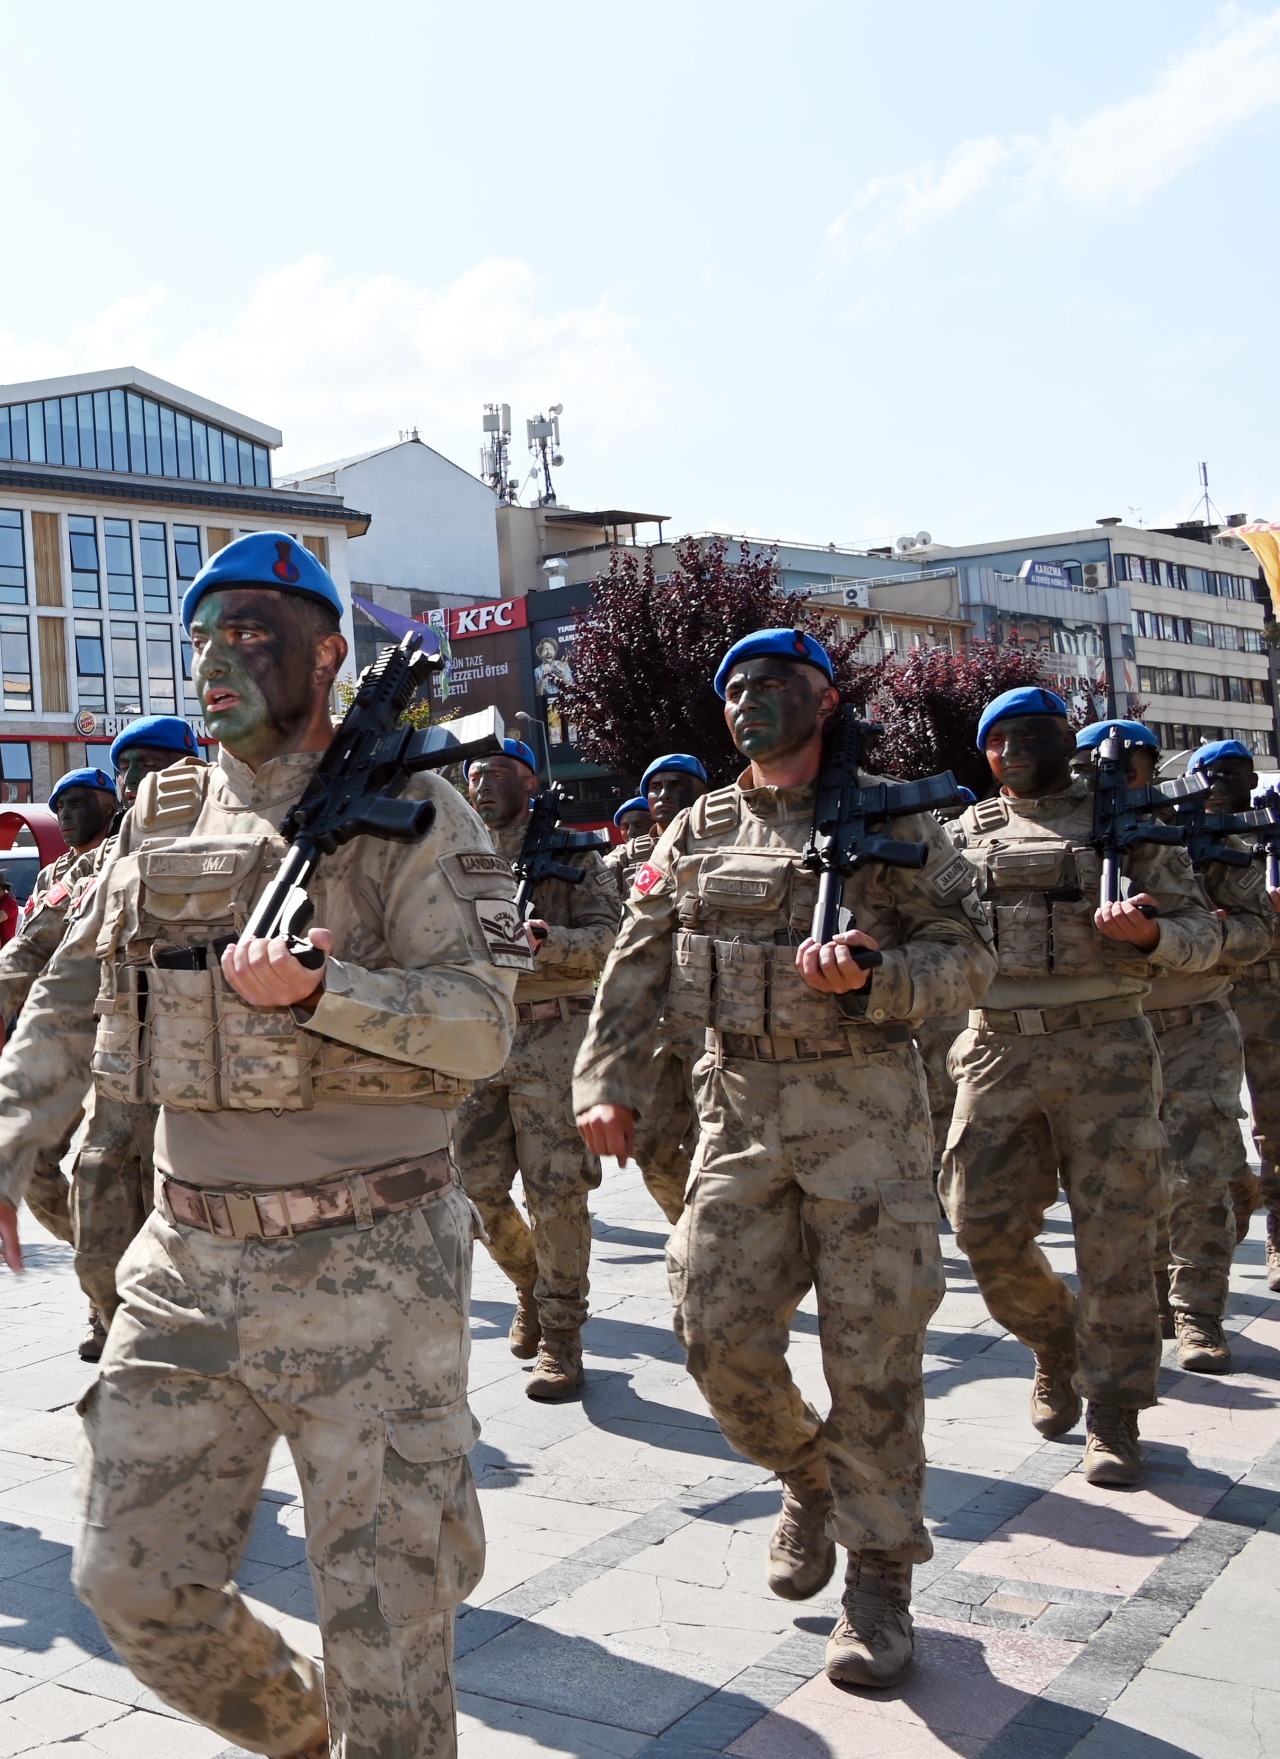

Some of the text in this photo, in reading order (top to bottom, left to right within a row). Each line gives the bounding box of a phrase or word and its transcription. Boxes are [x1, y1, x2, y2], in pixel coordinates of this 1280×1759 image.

[456, 602, 513, 634] KFC
[465, 655, 484, 668] TAZE
[485, 662, 509, 677] ÖTESİ
[81, 719, 95, 730] KING
